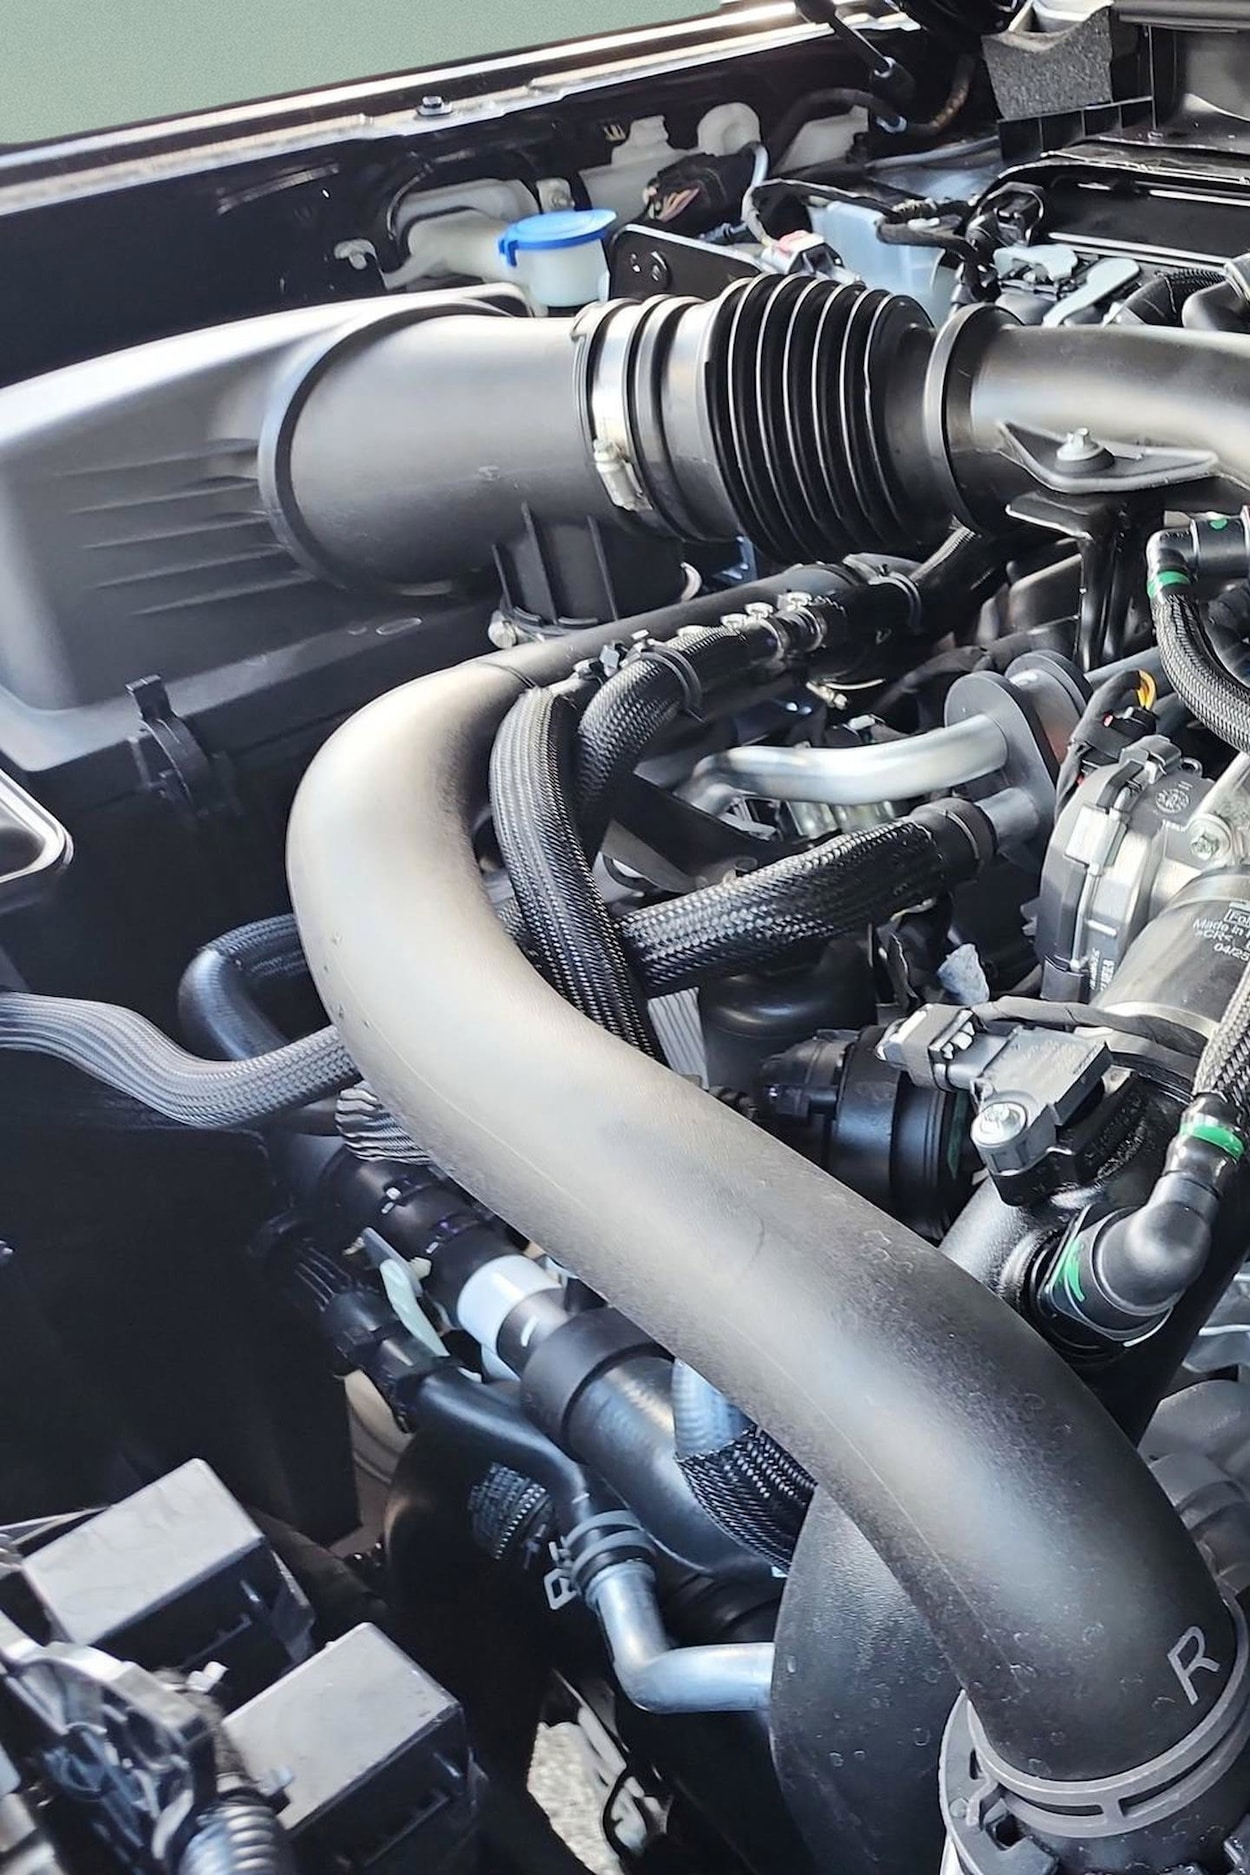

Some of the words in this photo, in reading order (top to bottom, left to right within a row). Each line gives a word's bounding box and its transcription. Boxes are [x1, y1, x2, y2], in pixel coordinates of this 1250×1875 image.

[1192, 918, 1229, 932] Made
[1231, 925, 1244, 937] in
[1167, 1626, 1220, 1705] R
